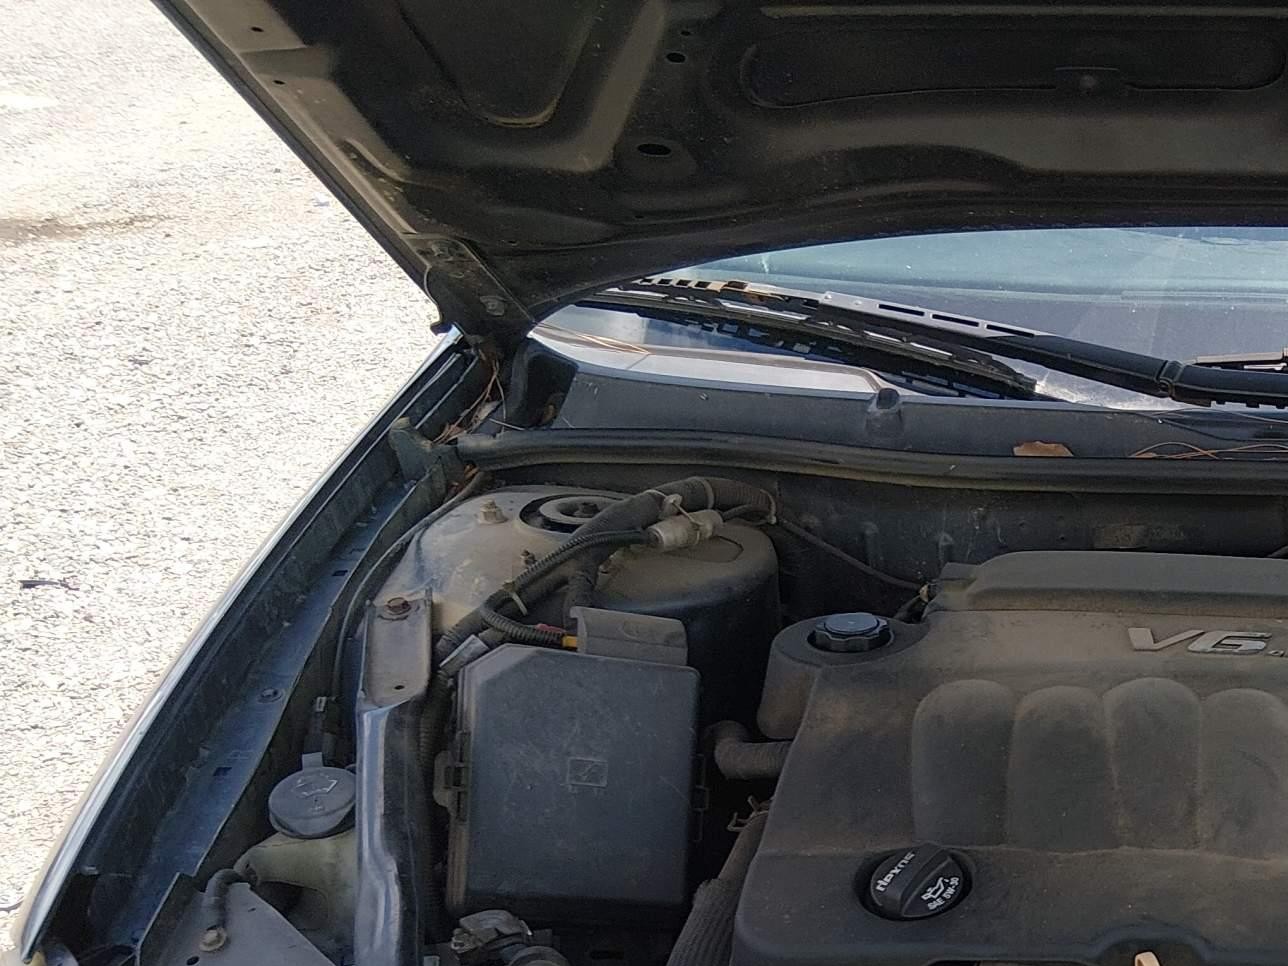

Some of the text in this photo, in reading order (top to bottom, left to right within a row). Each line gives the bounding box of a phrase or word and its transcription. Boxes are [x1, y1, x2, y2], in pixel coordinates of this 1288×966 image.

[1131, 628, 1271, 654] V6
[927, 877, 959, 910] SAE 5W-30
